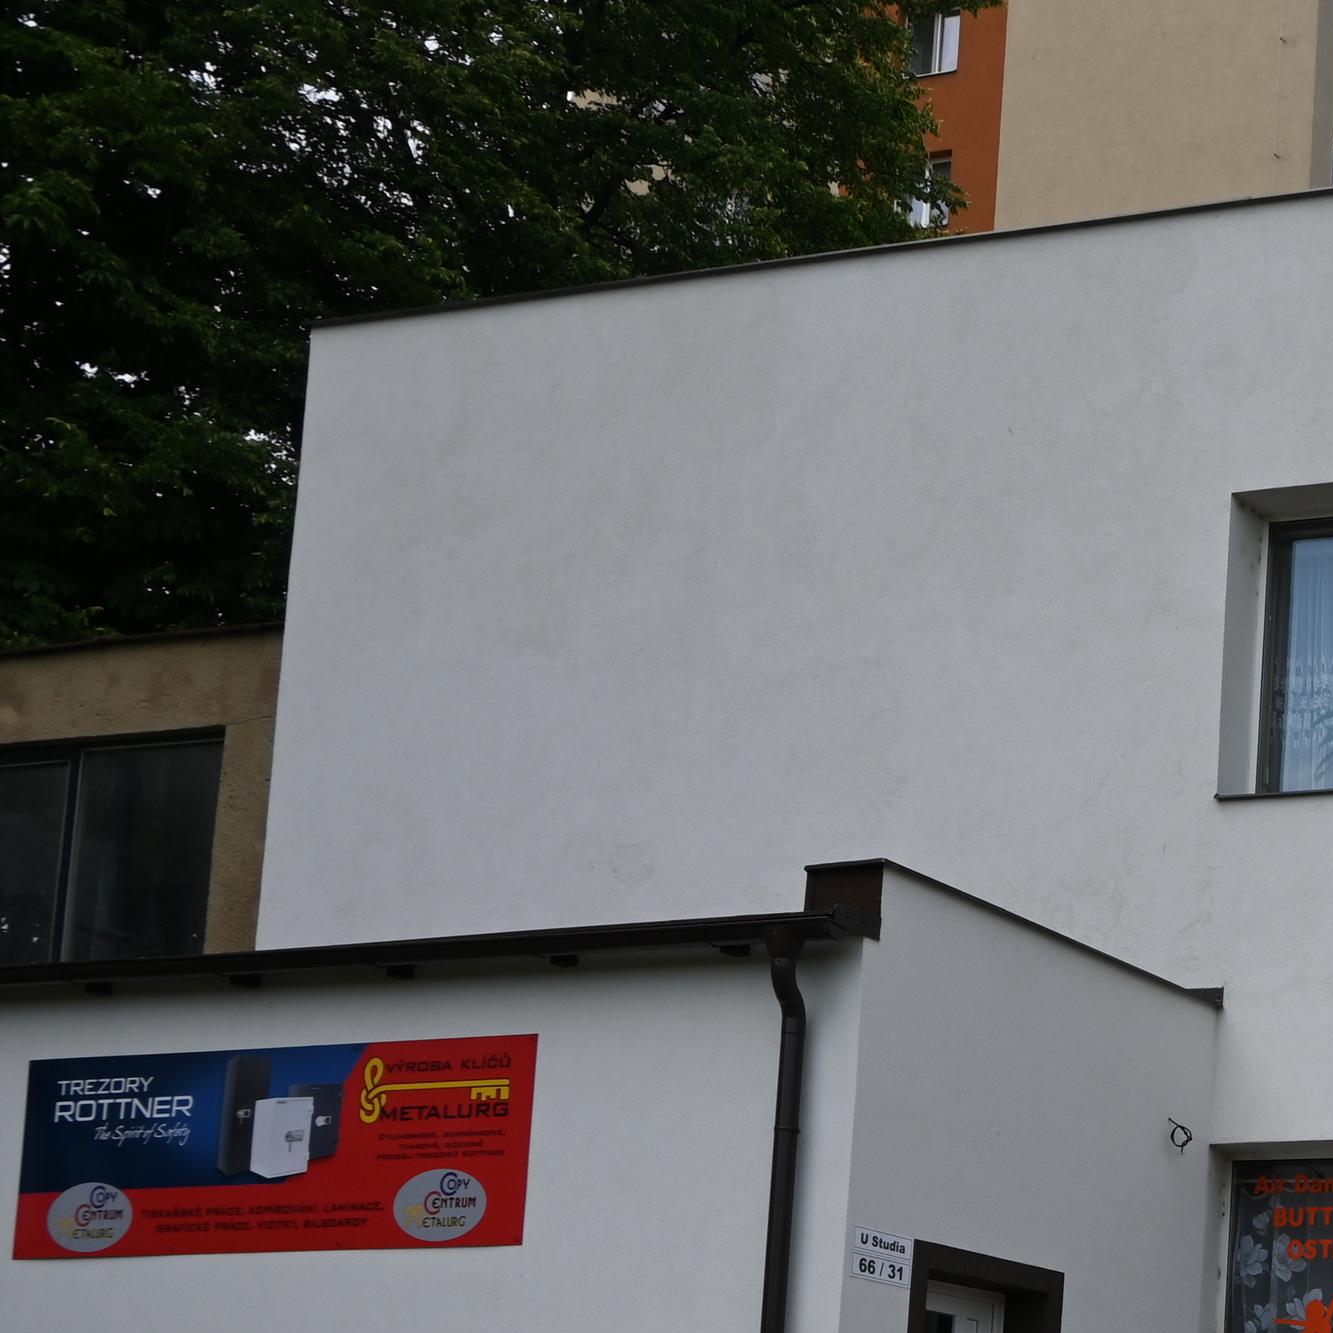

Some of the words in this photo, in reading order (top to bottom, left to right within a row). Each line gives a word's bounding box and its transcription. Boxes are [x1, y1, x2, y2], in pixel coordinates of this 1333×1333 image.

[385, 1058, 452, 1073] VÝROBA
[460, 1053, 511, 1069] KLÍČŮ
[57, 1077, 154, 1096] TREZORY
[54, 1095, 194, 1123] ROTTNER
[380, 1102, 509, 1121] METALURG
[94, 1122, 111, 1140] The
[1254, 1174, 1286, 1194] Air
[860, 1232, 869, 1245] U
[871, 1235, 906, 1254] Studia
[858, 1257, 876, 1275] 66
[887, 1263, 903, 1281] 31
